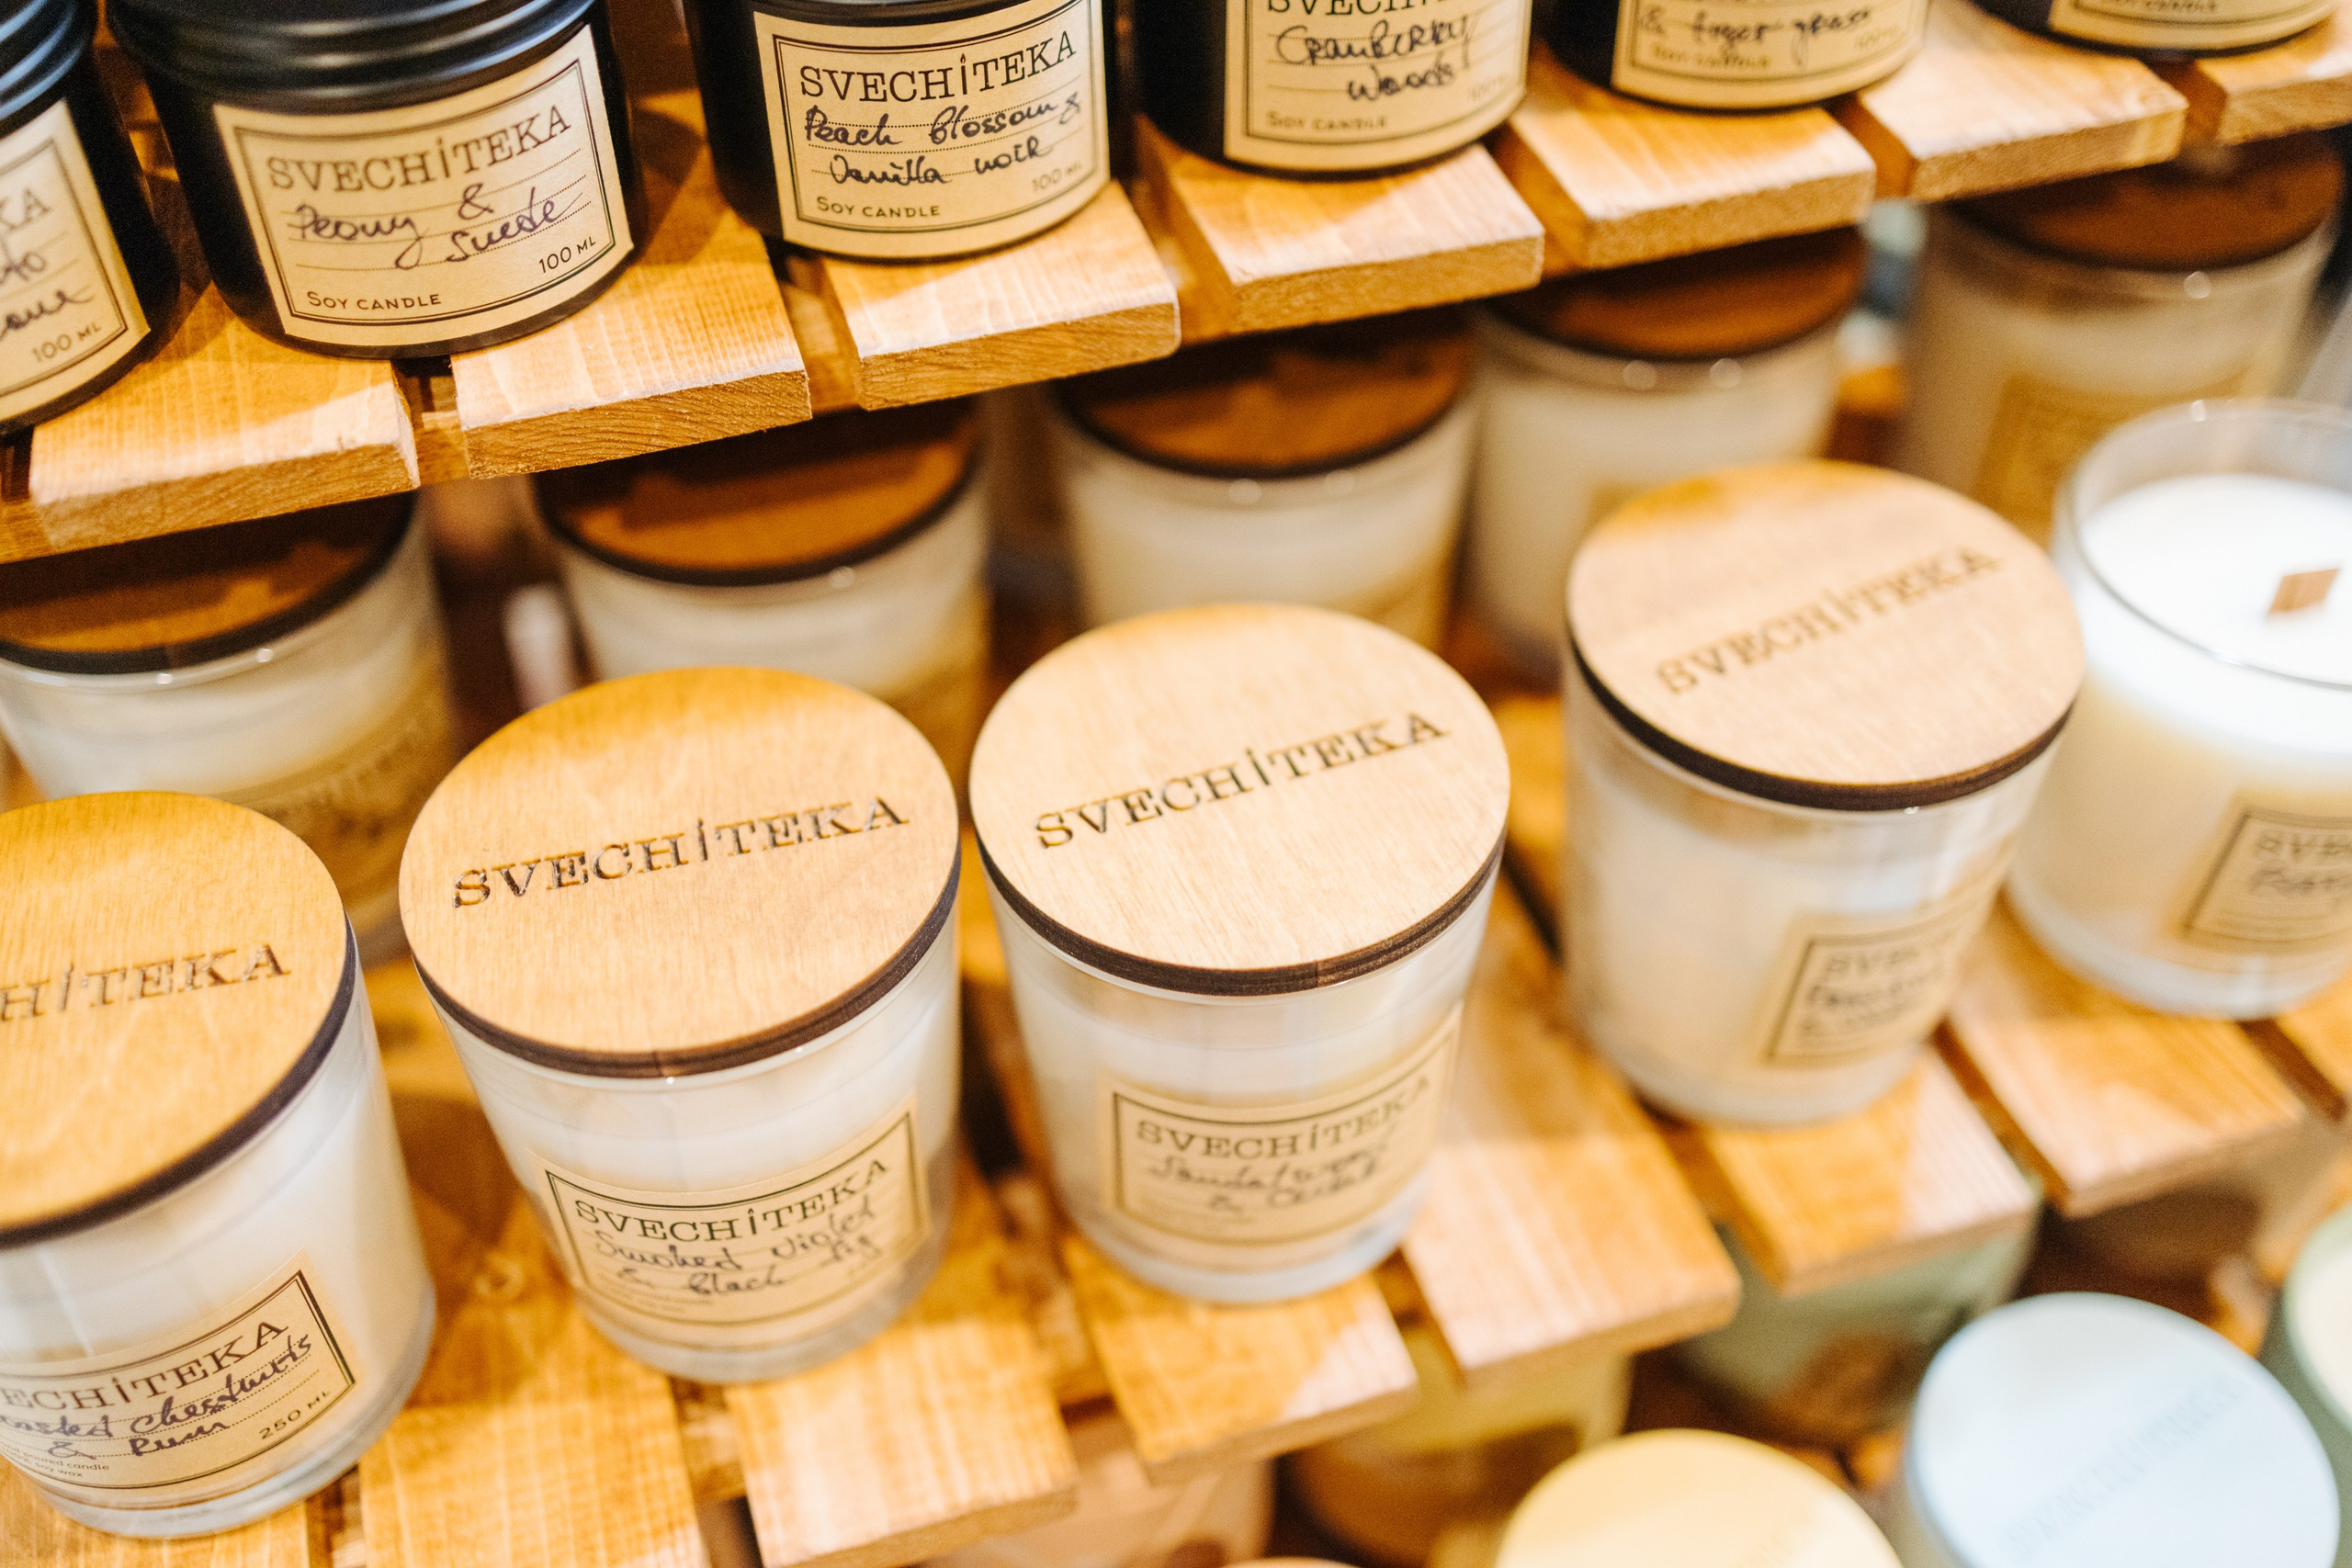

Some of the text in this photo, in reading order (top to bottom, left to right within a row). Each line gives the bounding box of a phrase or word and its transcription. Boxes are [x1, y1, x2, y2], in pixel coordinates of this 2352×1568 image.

[805, 105, 902, 146] Peach
[287, 182, 494, 270] Peony &
[537, 245, 572, 274] 100
[31, 333, 72, 363] 100
[1033, 711, 1453, 850] SVECHITEKA
[452, 795, 910, 908] SVECHITEKA
[258, 1407, 302, 1440] 250
[57, 1468, 84, 1478] wax
[66, 1461, 110, 1472] candle
